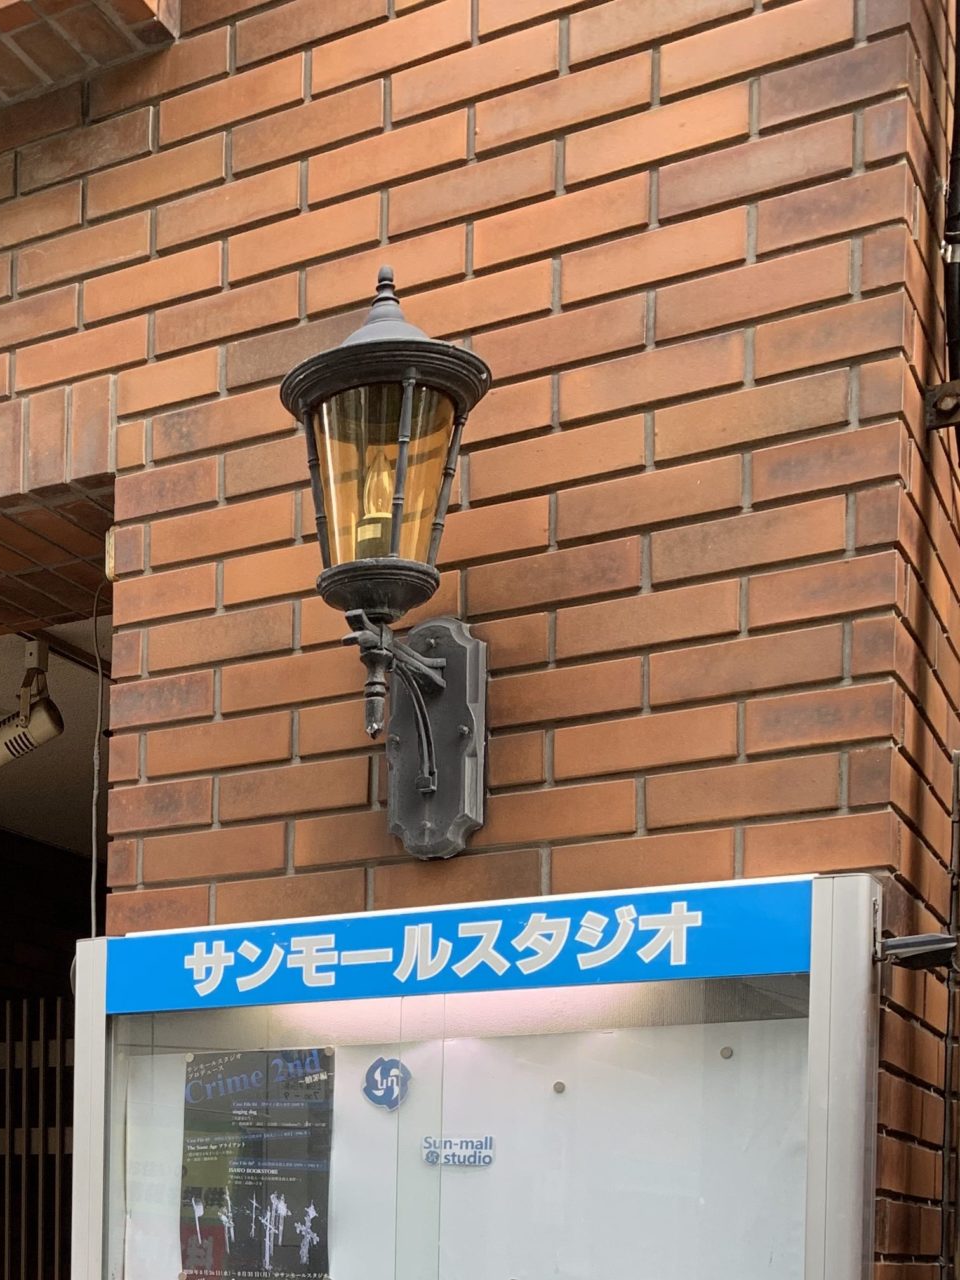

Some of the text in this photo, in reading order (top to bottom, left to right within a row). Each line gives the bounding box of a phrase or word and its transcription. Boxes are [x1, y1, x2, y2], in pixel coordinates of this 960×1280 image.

[184, 901, 702, 997] サンモールスタジオ
[185, 1048, 321, 1103] Crime 2nd
[424, 1136, 493, 1150] Sun-mall
[444, 1151, 493, 1165] studio
